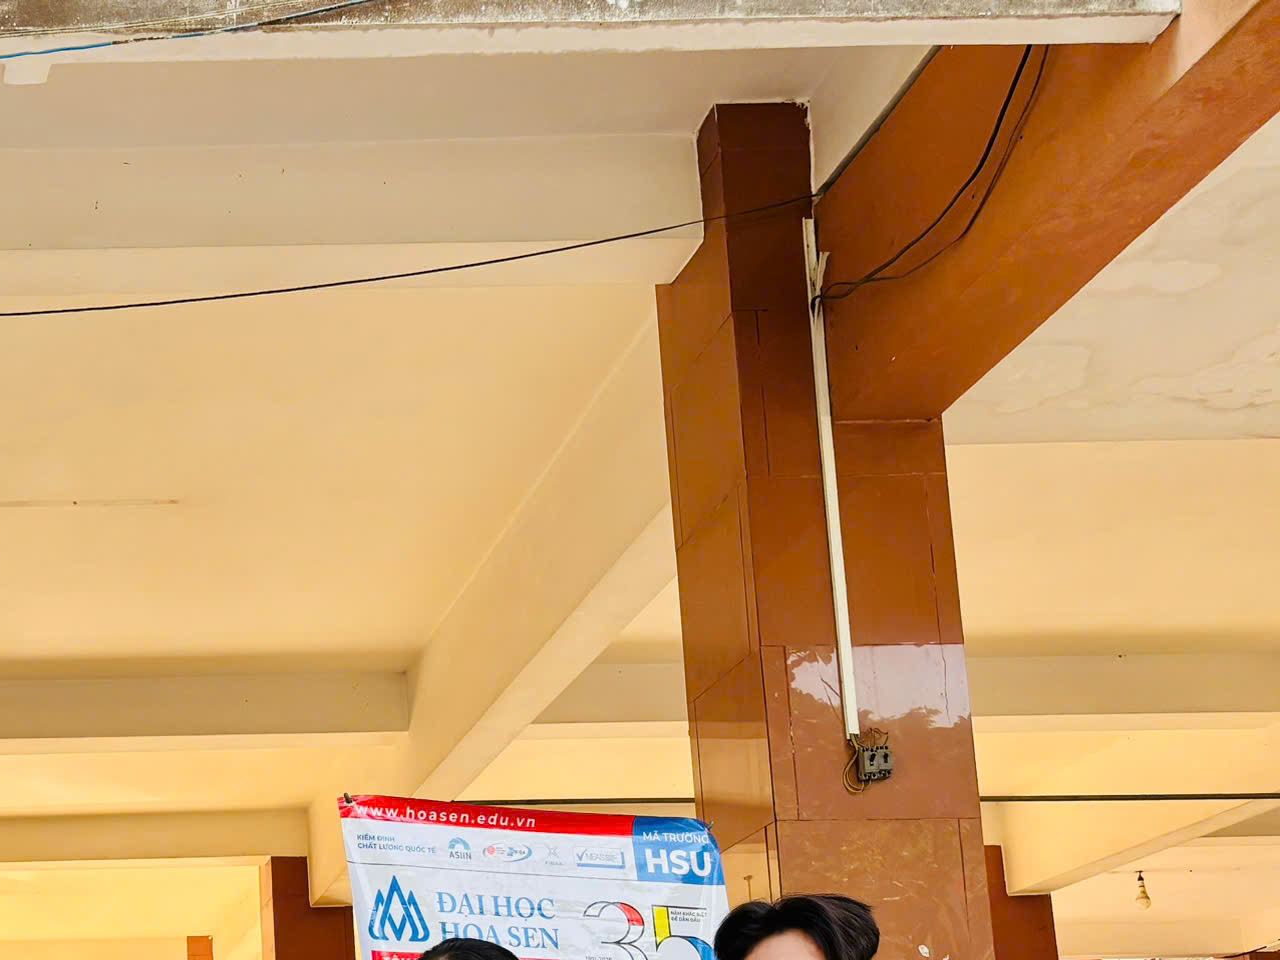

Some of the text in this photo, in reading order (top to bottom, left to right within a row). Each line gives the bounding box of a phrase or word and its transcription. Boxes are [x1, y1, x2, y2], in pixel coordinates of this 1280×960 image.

[354, 804, 536, 828] www.hoasen.edu.vn
[643, 831, 709, 844] MÃ TRƯỜNG
[645, 848, 711, 877] HSU
[435, 891, 556, 922] ĐẠI HỌC
[508, 925, 560, 950] SEN
